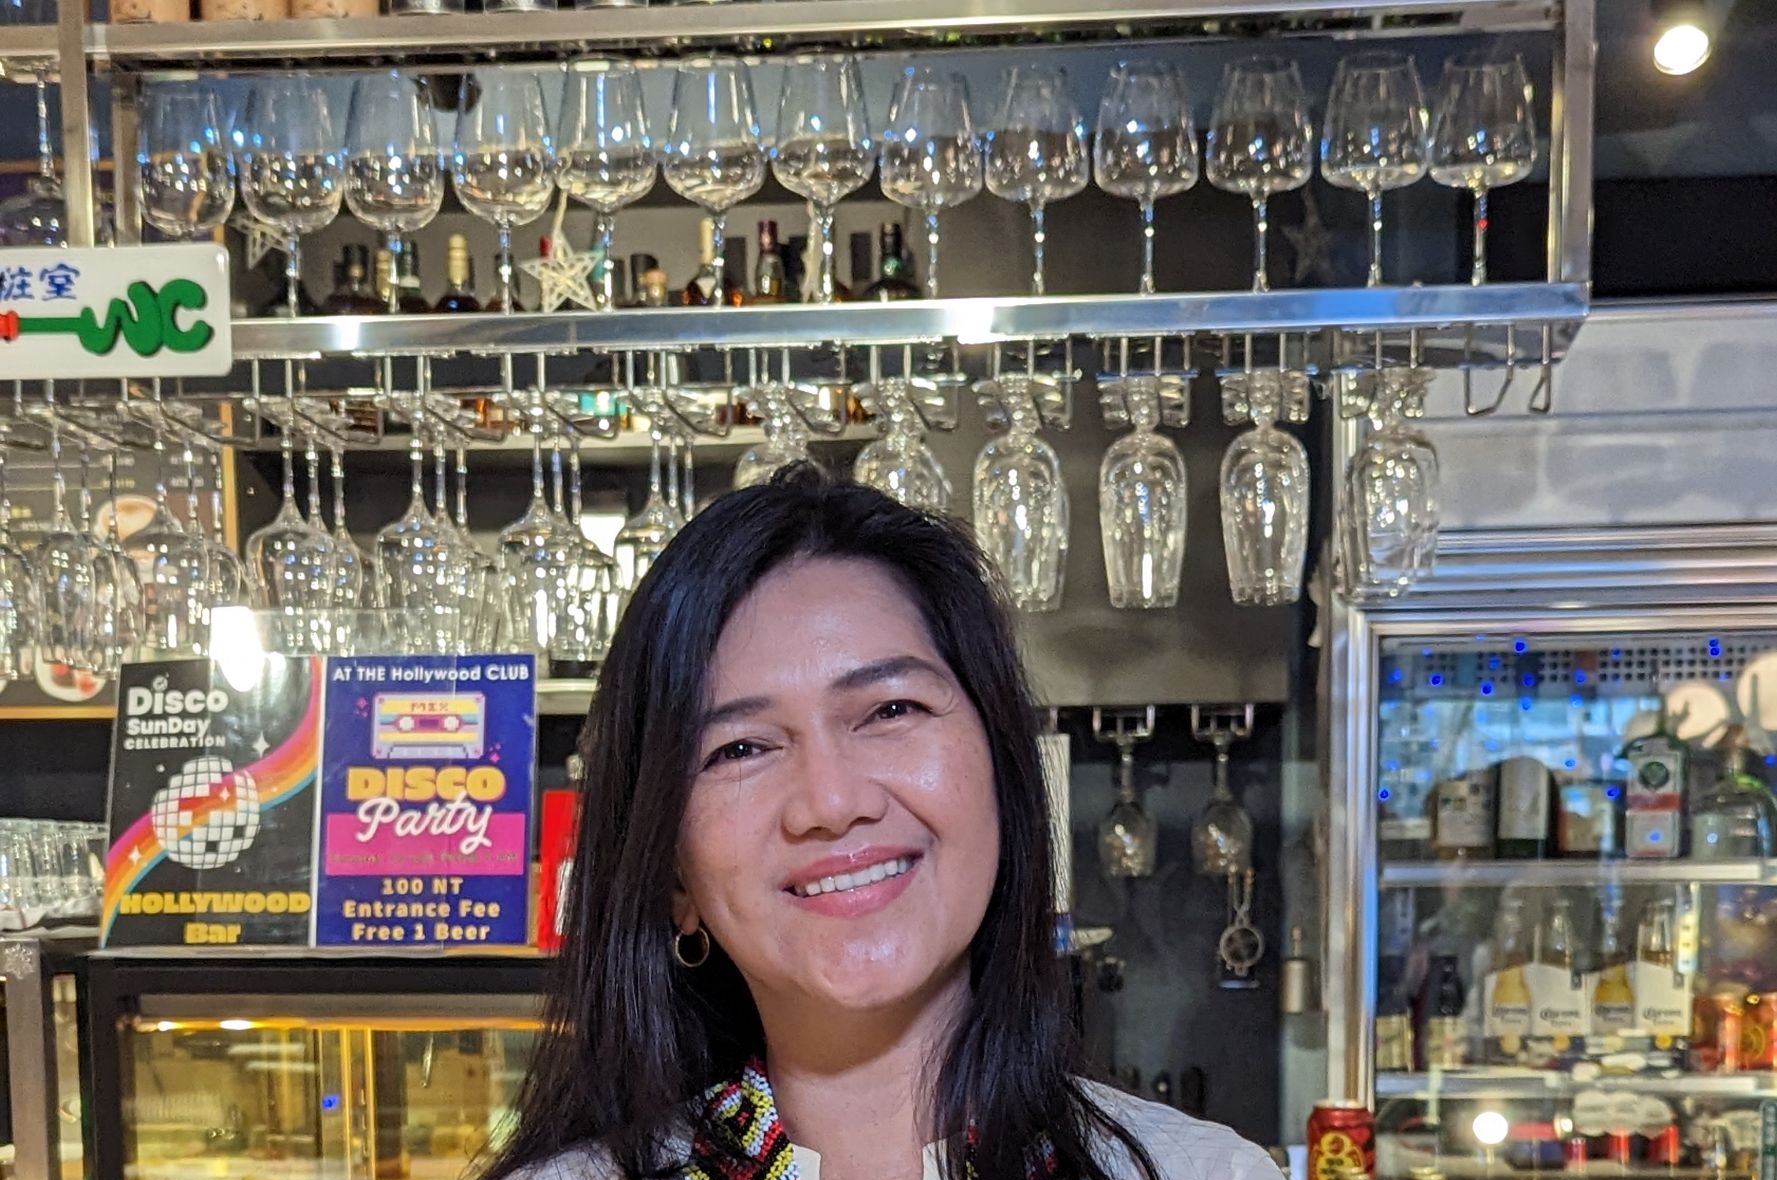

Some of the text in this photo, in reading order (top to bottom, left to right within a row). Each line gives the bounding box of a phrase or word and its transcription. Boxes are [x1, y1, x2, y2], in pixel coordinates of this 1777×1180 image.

[79, 278, 215, 357] WC
[333, 664, 529, 683] AT THE Hollywood CLUB
[126, 676, 229, 716] Disco
[126, 716, 211, 738] SunDay
[123, 736, 226, 750] CELEBRATION
[347, 766, 507, 801] DISCO
[355, 792, 493, 855] Party
[382, 878, 464, 896] 100 NT
[119, 892, 311, 915] HOLLYWOOD
[342, 899, 501, 919] Entrance Fee
[184, 922, 242, 944] Bar
[351, 923, 491, 941] Free 1 Beer
